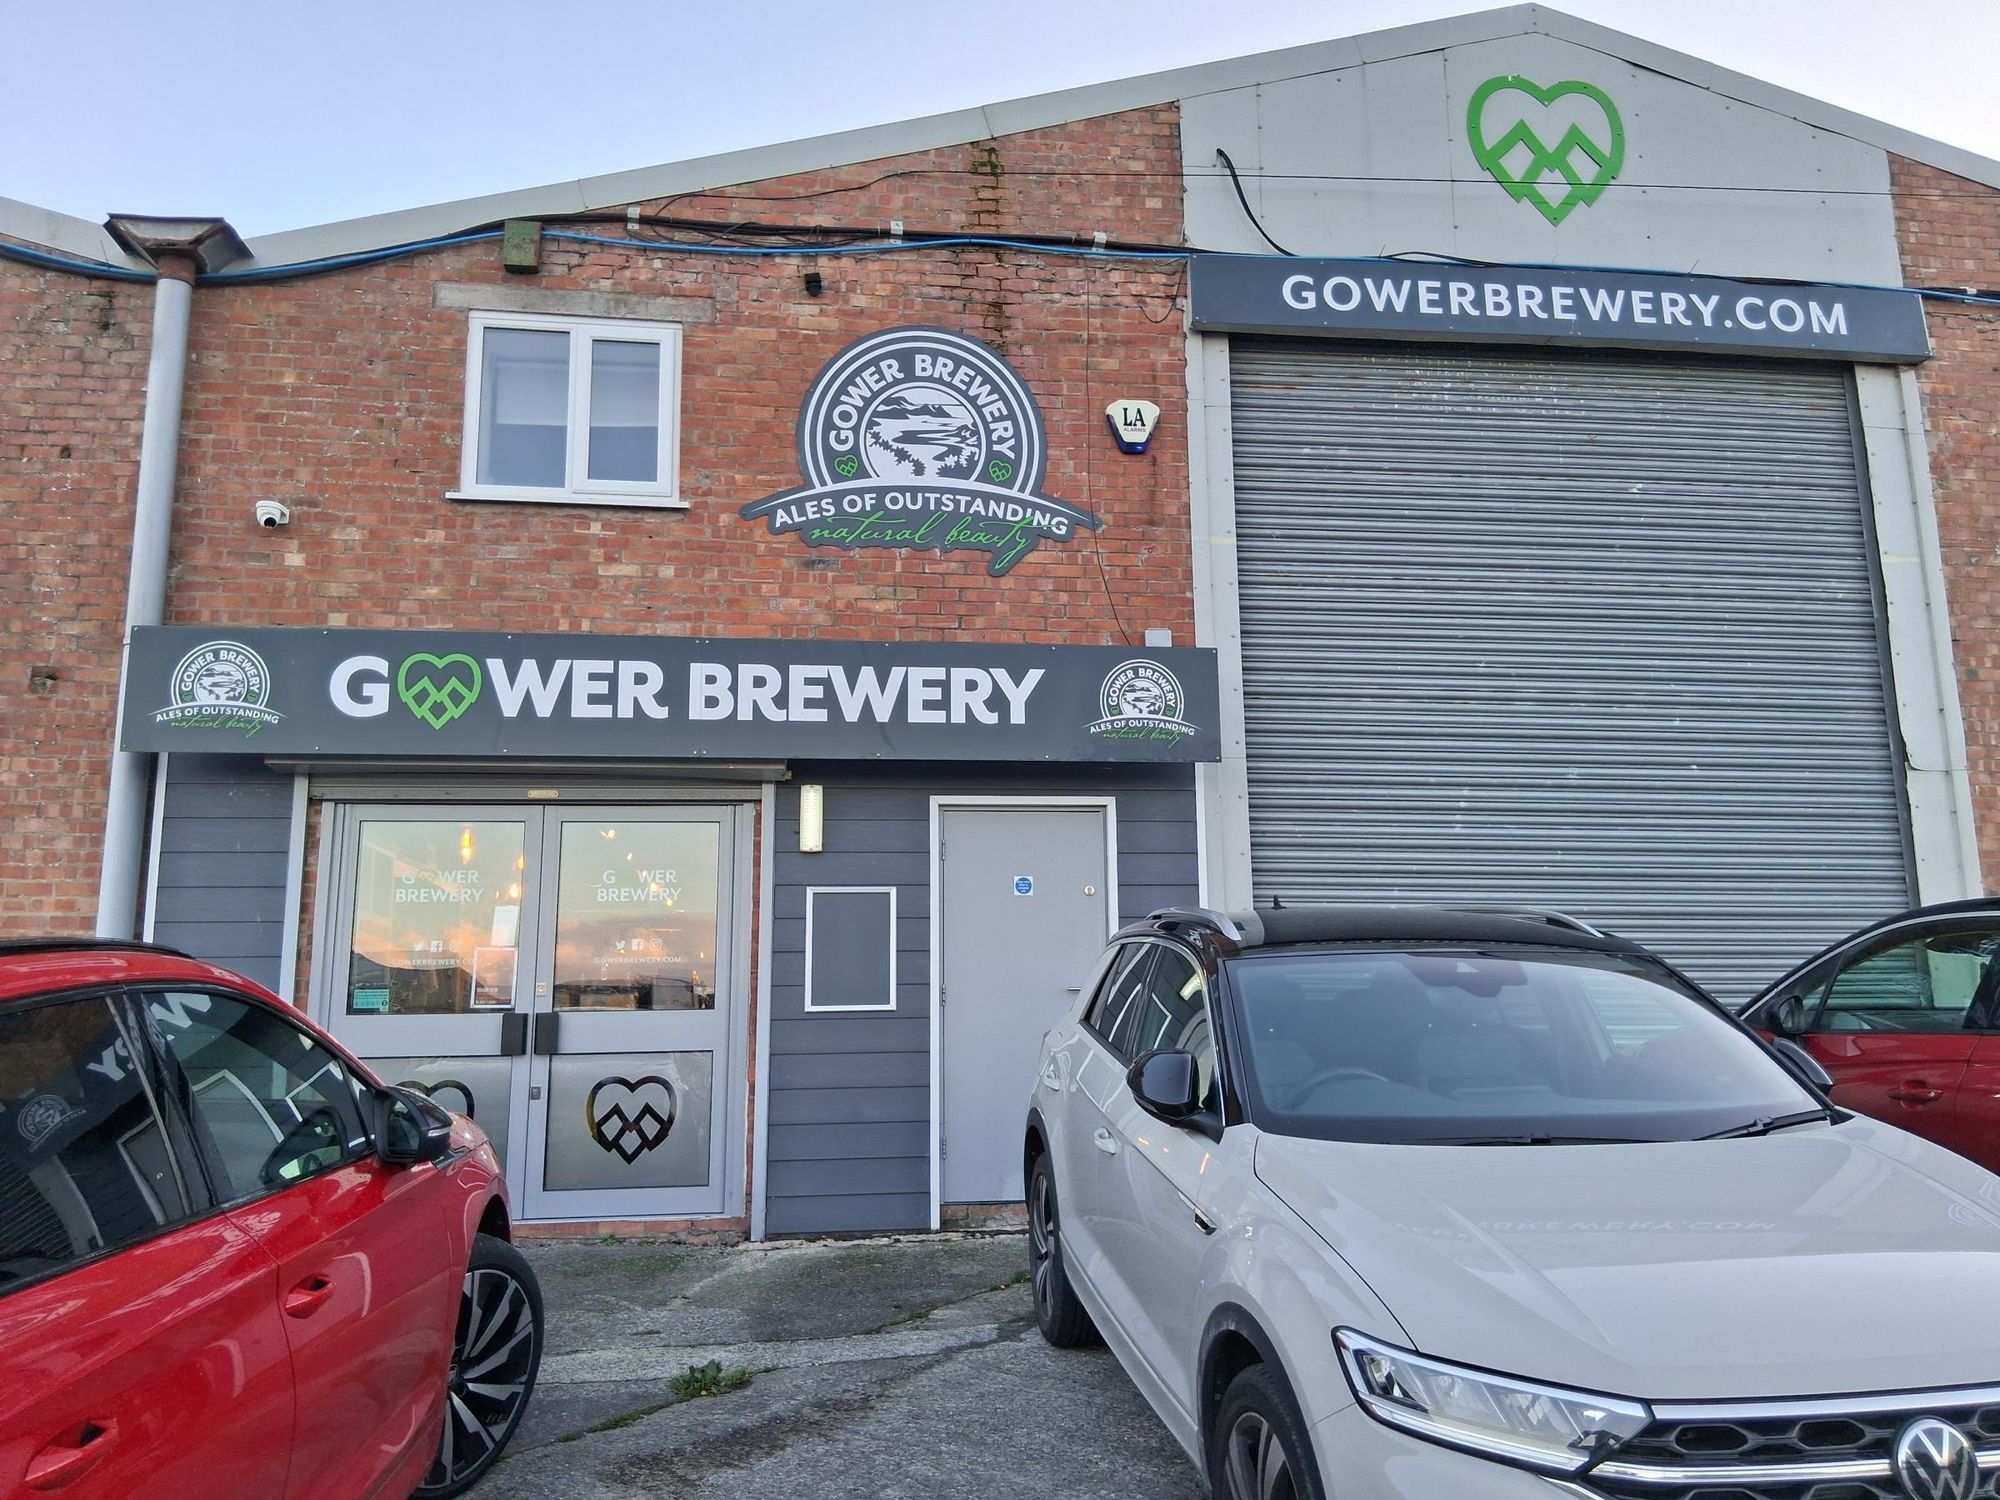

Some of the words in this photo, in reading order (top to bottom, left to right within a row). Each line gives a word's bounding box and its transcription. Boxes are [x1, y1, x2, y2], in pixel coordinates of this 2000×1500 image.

[1281, 274, 1848, 336] GOWERBREWERY.COM
[829, 358, 905, 452] GOWER
[914, 353, 1016, 460] BREWERY
[1122, 407, 1147, 427] LA
[774, 498, 836, 528] ALES
[842, 492, 877, 514] OF
[884, 491, 1069, 536] OUTSTANDING
[809, 510, 948, 546] natural
[943, 515, 1059, 570] beauty
[181, 651, 216, 692] GOWER
[219, 649, 261, 694] BREWERY
[1108, 668, 1135, 706] GOWER
[1138, 667, 1176, 708] BREWERY
[156, 710, 183, 723] ALES
[184, 706, 200, 716] OF
[202, 705, 280, 724] OUTSTANDING
[688, 662, 1046, 725] BREWERY
[1090, 722, 1112, 734] ALES
[1113, 720, 1127, 729] OF
[1128, 719, 1196, 736] OUTSTANDING
[396, 887, 484, 902] BREWERY
[597, 887, 682, 902] BREWERY
